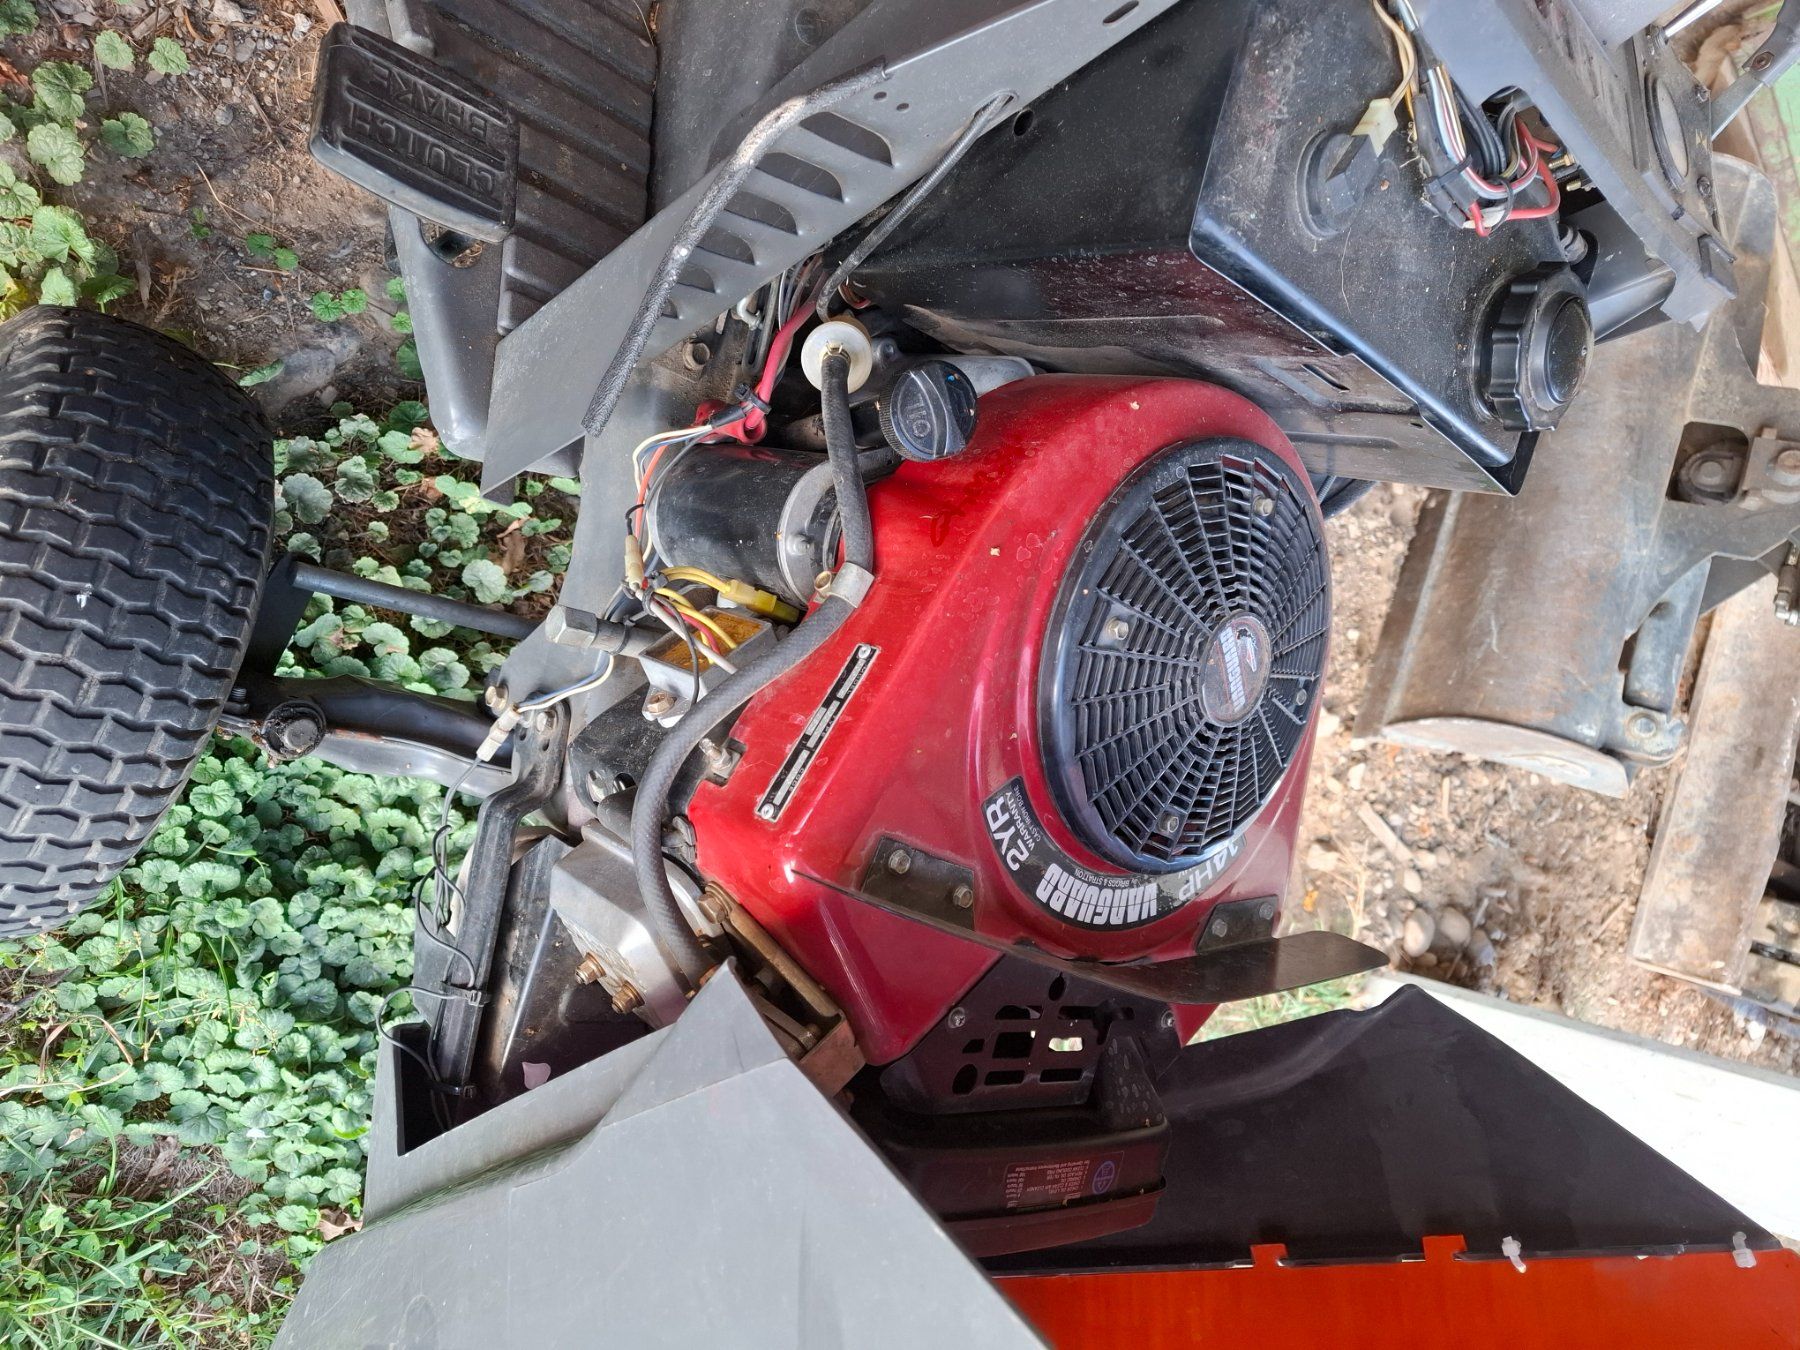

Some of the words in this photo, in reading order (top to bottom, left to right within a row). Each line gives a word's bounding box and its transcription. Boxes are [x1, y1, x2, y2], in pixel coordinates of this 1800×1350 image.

[368, 60, 489, 141] BRAKE
[348, 101, 495, 198] CLUTCH
[905, 393, 931, 438] OIL
[1220, 626, 1246, 713] VANGUARD
[1005, 791, 1036, 851] WARRANTY
[1036, 863, 1158, 925] VANGUARD
[1075, 868, 1103, 886] STRATTON
[1107, 877, 1130, 888] BRIGGS
